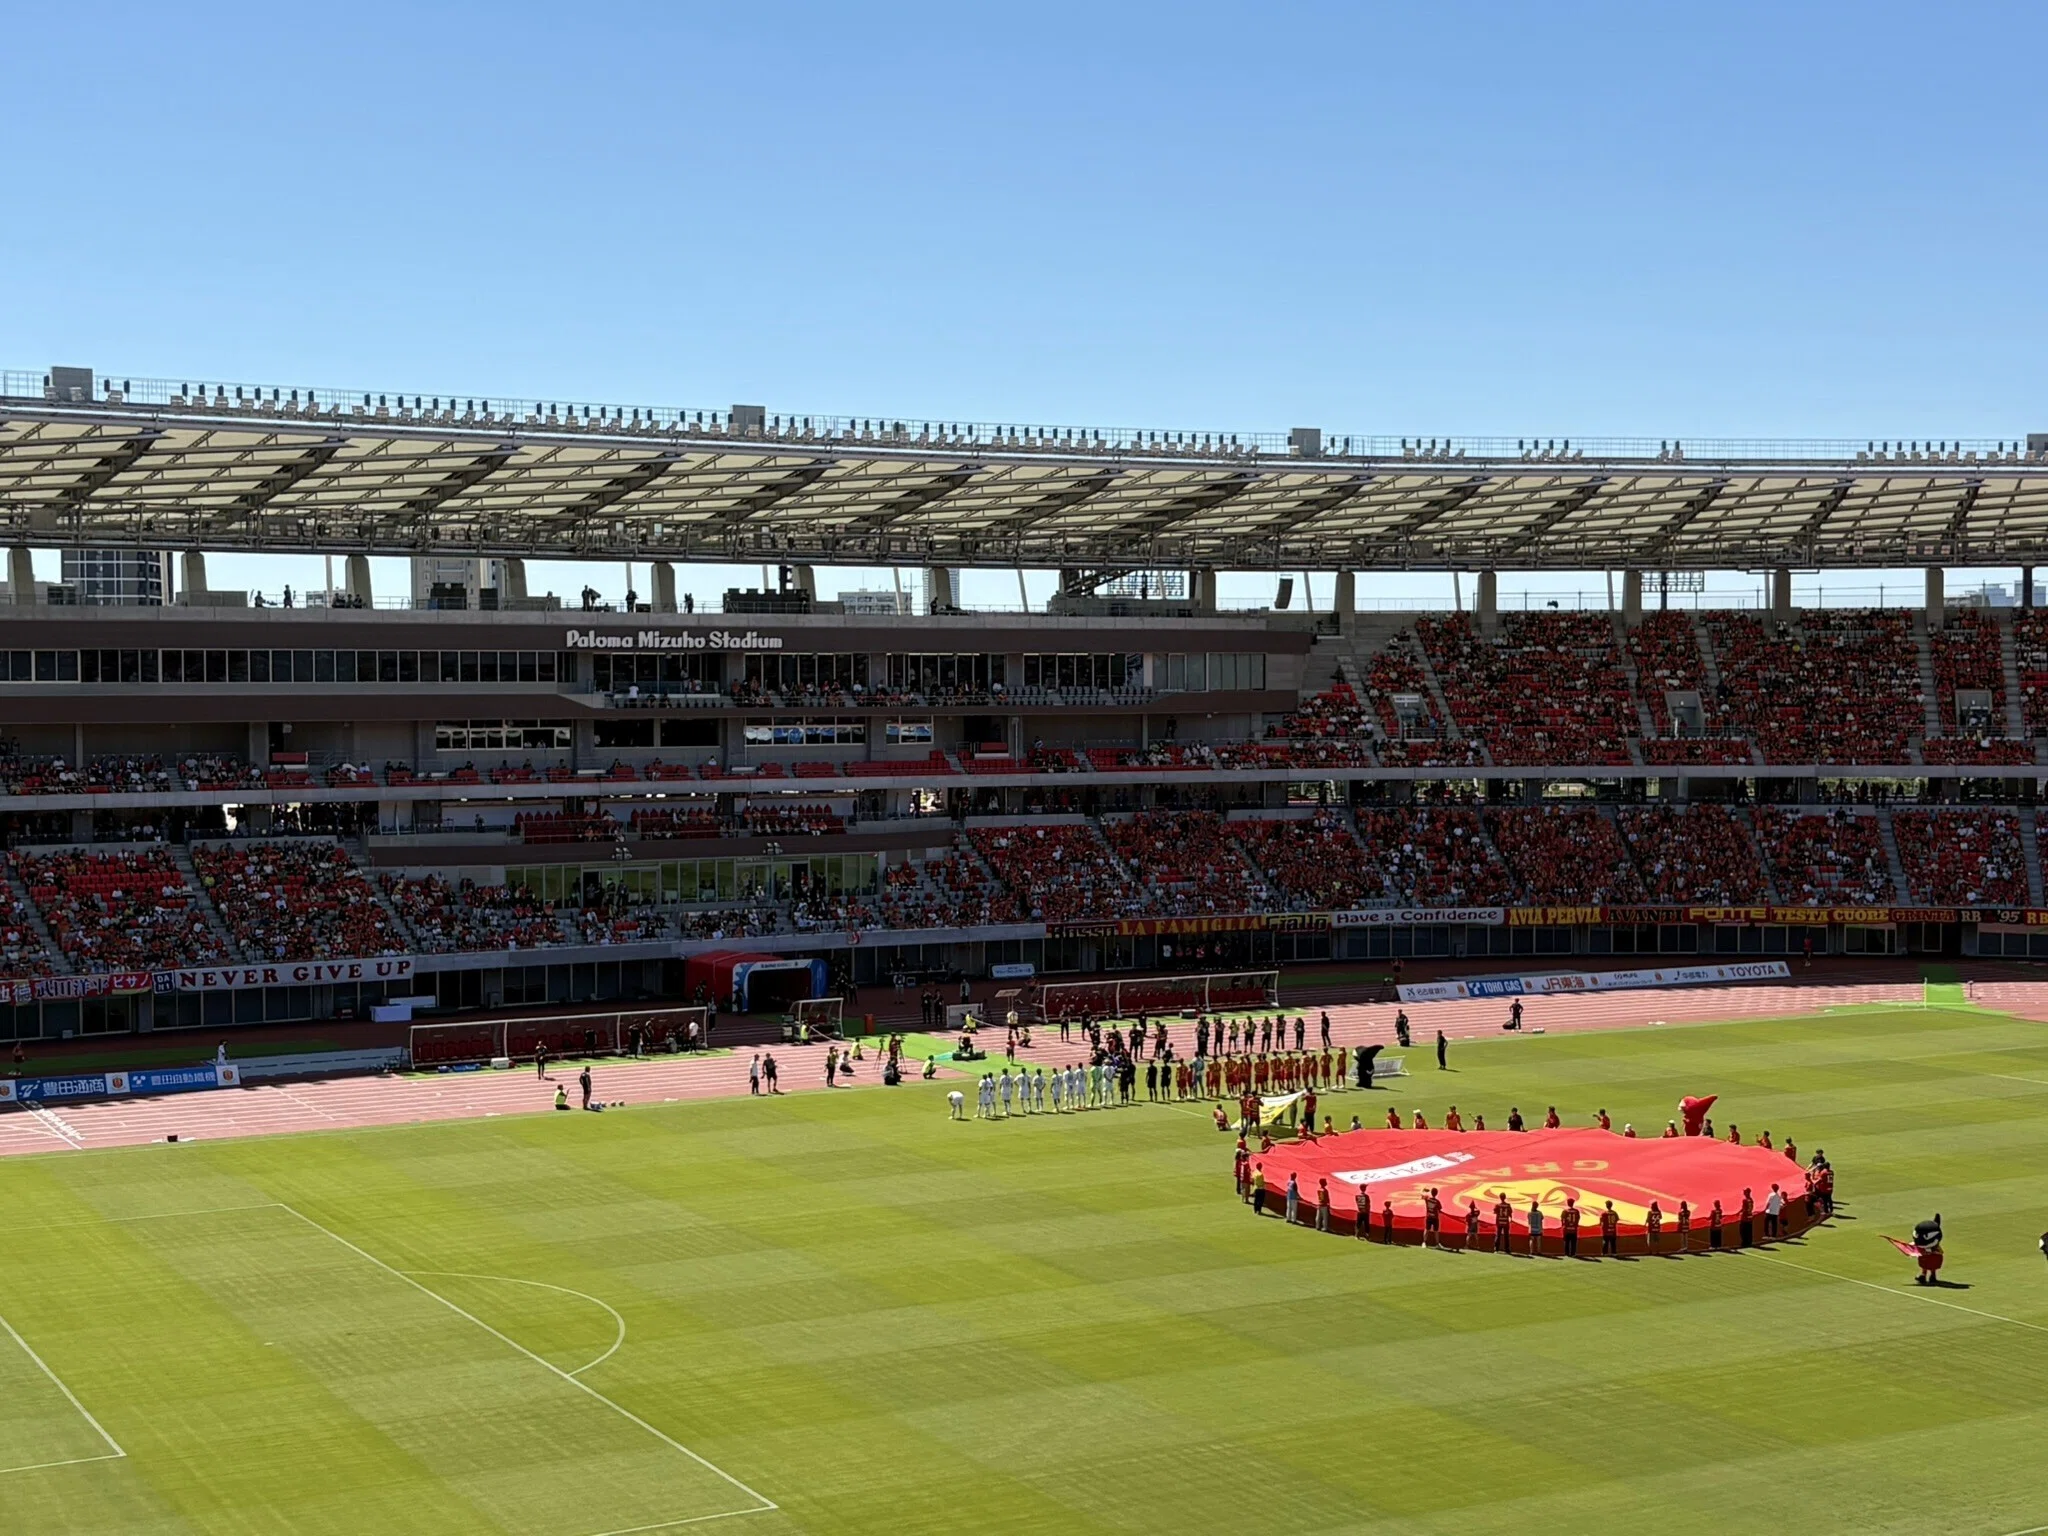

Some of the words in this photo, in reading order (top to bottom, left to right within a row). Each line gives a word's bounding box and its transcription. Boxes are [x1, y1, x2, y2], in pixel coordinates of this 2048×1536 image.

[566, 629, 633, 648] Paloma
[638, 630, 706, 648] Mizuho
[709, 630, 783, 648] Stadium
[1336, 912, 1379, 924] Have
[1385, 912, 1395, 922] a
[1401, 909, 1498, 923] Confidence
[1509, 907, 1542, 925] AVIA
[1547, 907, 1601, 924] PERVIA
[1689, 907, 1766, 920] FONTE
[1773, 908, 1829, 922] TESTA
[1833, 908, 1889, 922] CUORE
[1961, 909, 1982, 923] RB
[1121, 919, 1146, 936] LA
[1155, 915, 1261, 935] FAMIGLIA
[180, 968, 279, 988] NEVER
[293, 963, 363, 981] GIVE
[376, 960, 411, 976] UP
[1729, 964, 1776, 978] TOYOTA
[113, 973, 149, 988] ピサノ
[1482, 980, 1503, 993] TOHO
[1504, 979, 1521, 991] GAS
[1541, 976, 1585, 991] JR東海
[43, 1079, 105, 1097] 豊田通商
